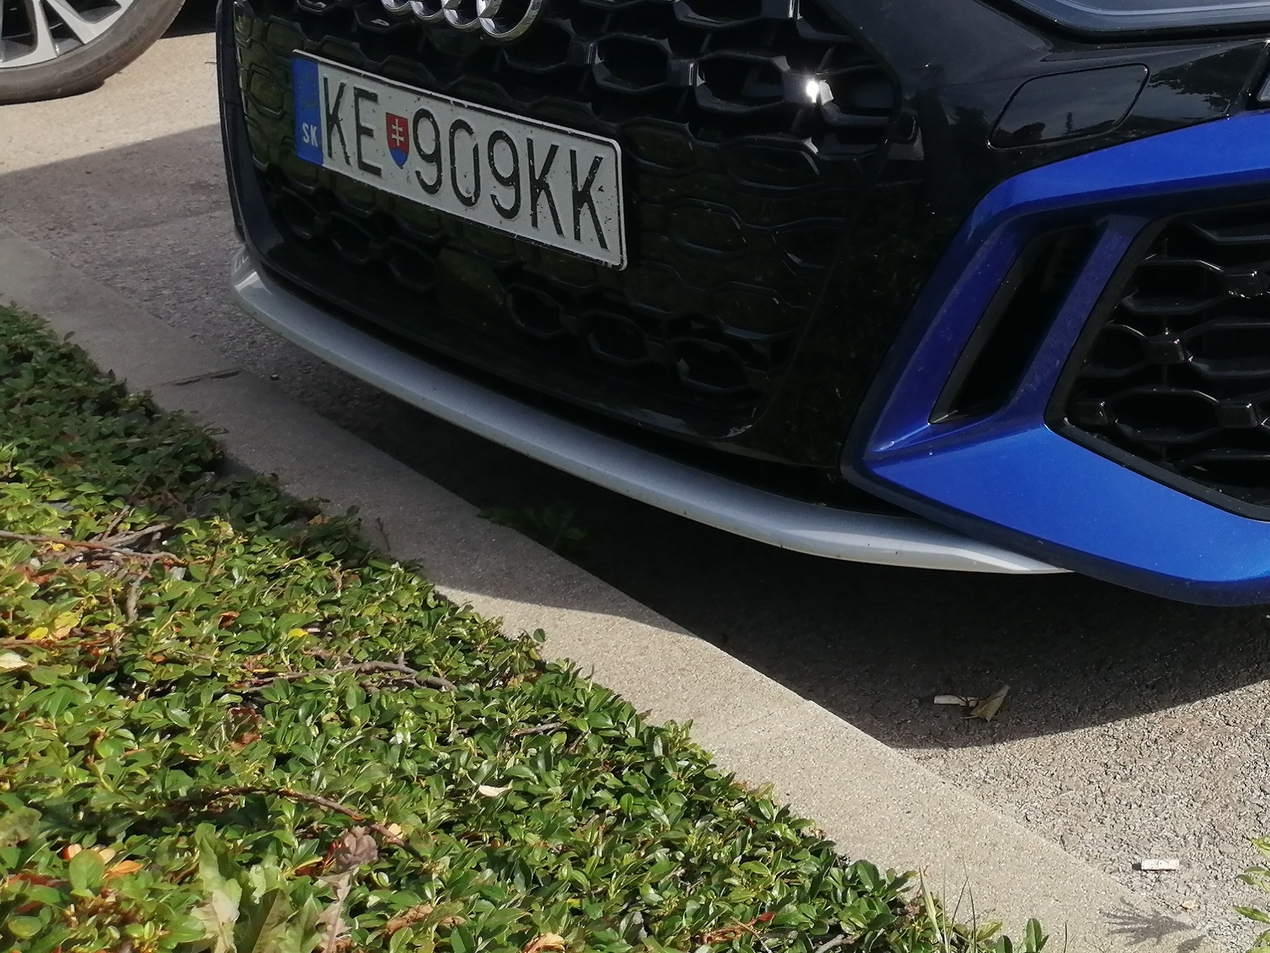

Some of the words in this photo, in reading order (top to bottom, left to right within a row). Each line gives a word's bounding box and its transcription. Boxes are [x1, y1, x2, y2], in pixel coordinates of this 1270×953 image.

[302, 122, 318, 147] SK
[323, 76, 383, 177] KE
[412, 107, 608, 249] 909KK
